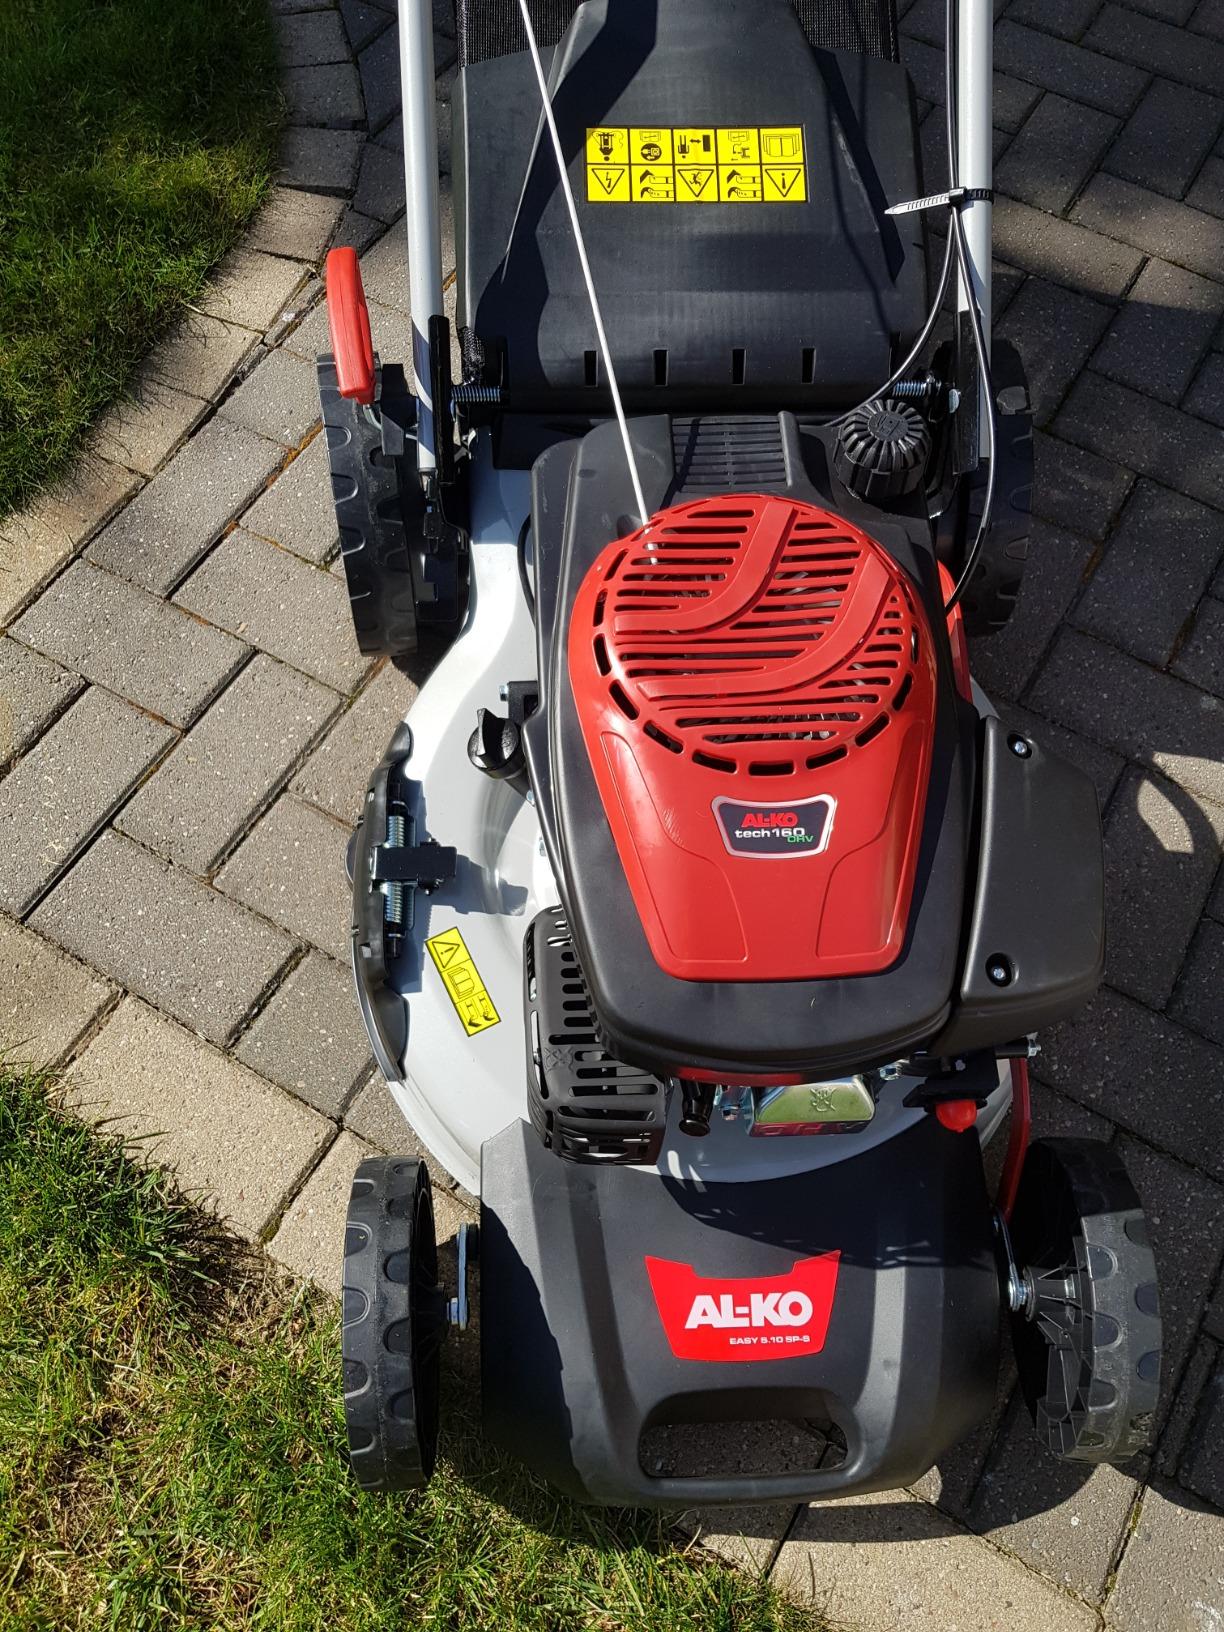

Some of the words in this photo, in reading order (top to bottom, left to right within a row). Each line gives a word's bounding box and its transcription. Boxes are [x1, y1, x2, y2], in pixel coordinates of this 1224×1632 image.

[741, 812, 798, 827] AL-KO
[684, 1290, 813, 1329] AL-KO
[729, 1337, 758, 1345] EASY
[785, 1335, 811, 1343] SP-S
